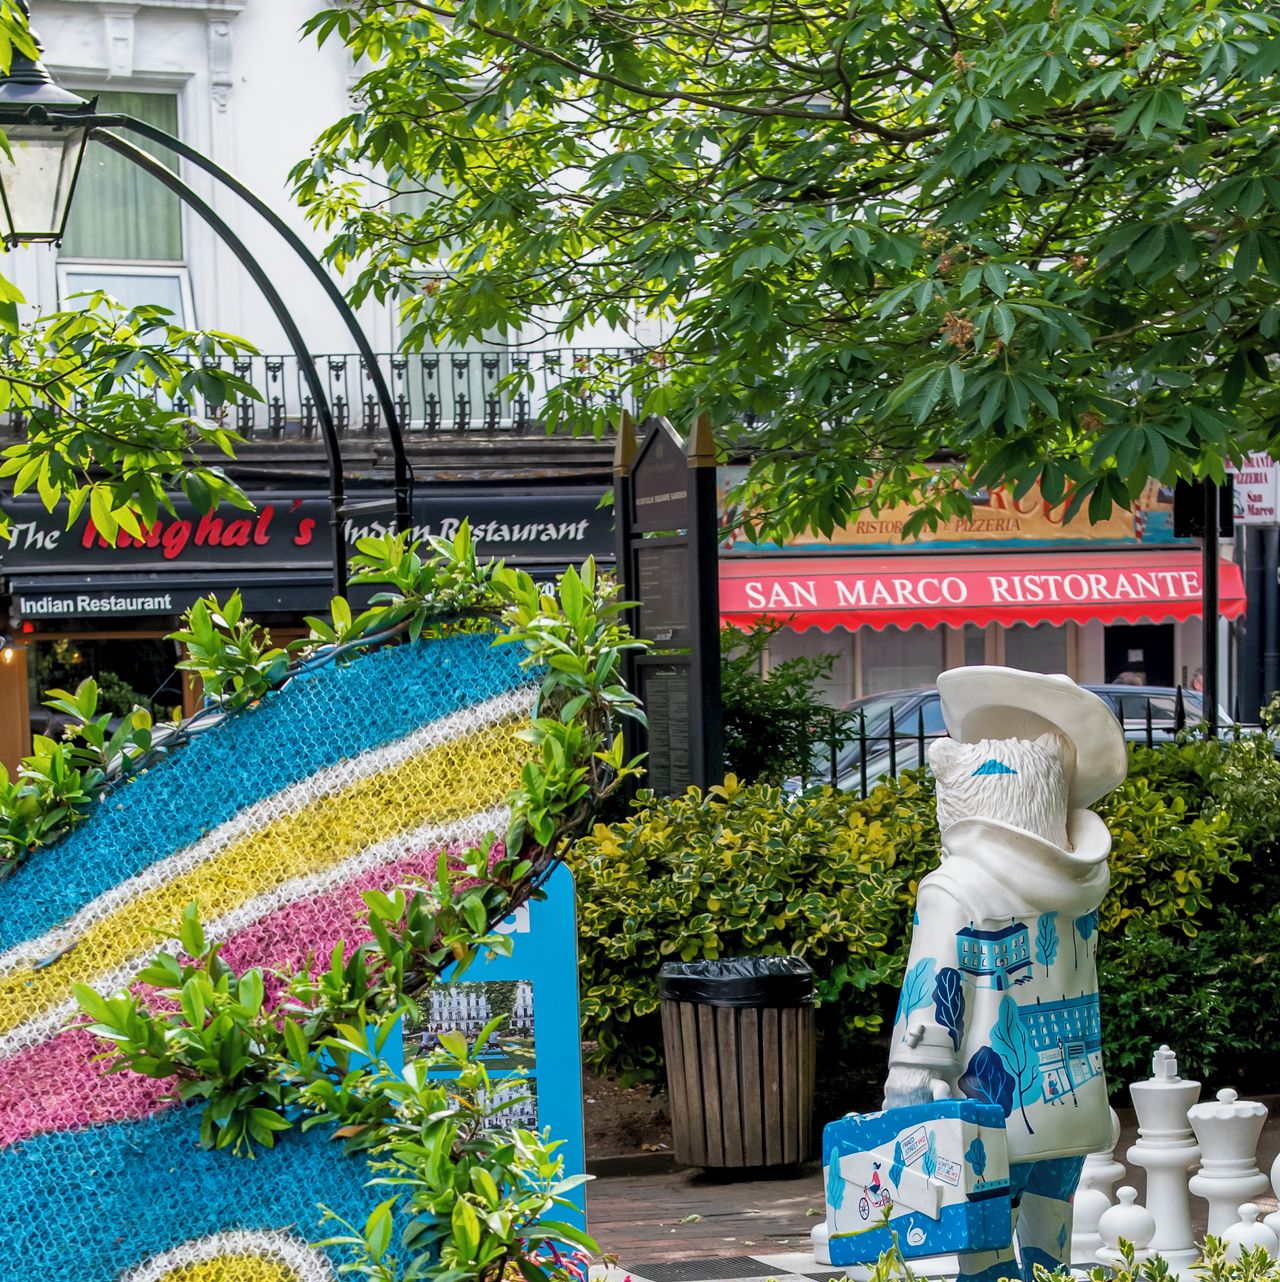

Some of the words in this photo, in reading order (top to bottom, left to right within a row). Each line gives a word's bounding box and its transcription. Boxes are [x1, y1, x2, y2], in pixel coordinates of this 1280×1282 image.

[1247, 491, 1263, 502] San
[1248, 504, 1274, 516] Marco
[955, 518, 1022, 532] PIZZERIA
[7, 521, 60, 551] The
[342, 519, 431, 544] Indin
[440, 517, 590, 542] Rstaurant
[745, 580, 818, 609] SAN
[833, 576, 968, 606] MARCO
[987, 570, 1203, 602] RISTORANTE
[20, 596, 74, 614] Indian
[77, 593, 172, 612] Restaurant
